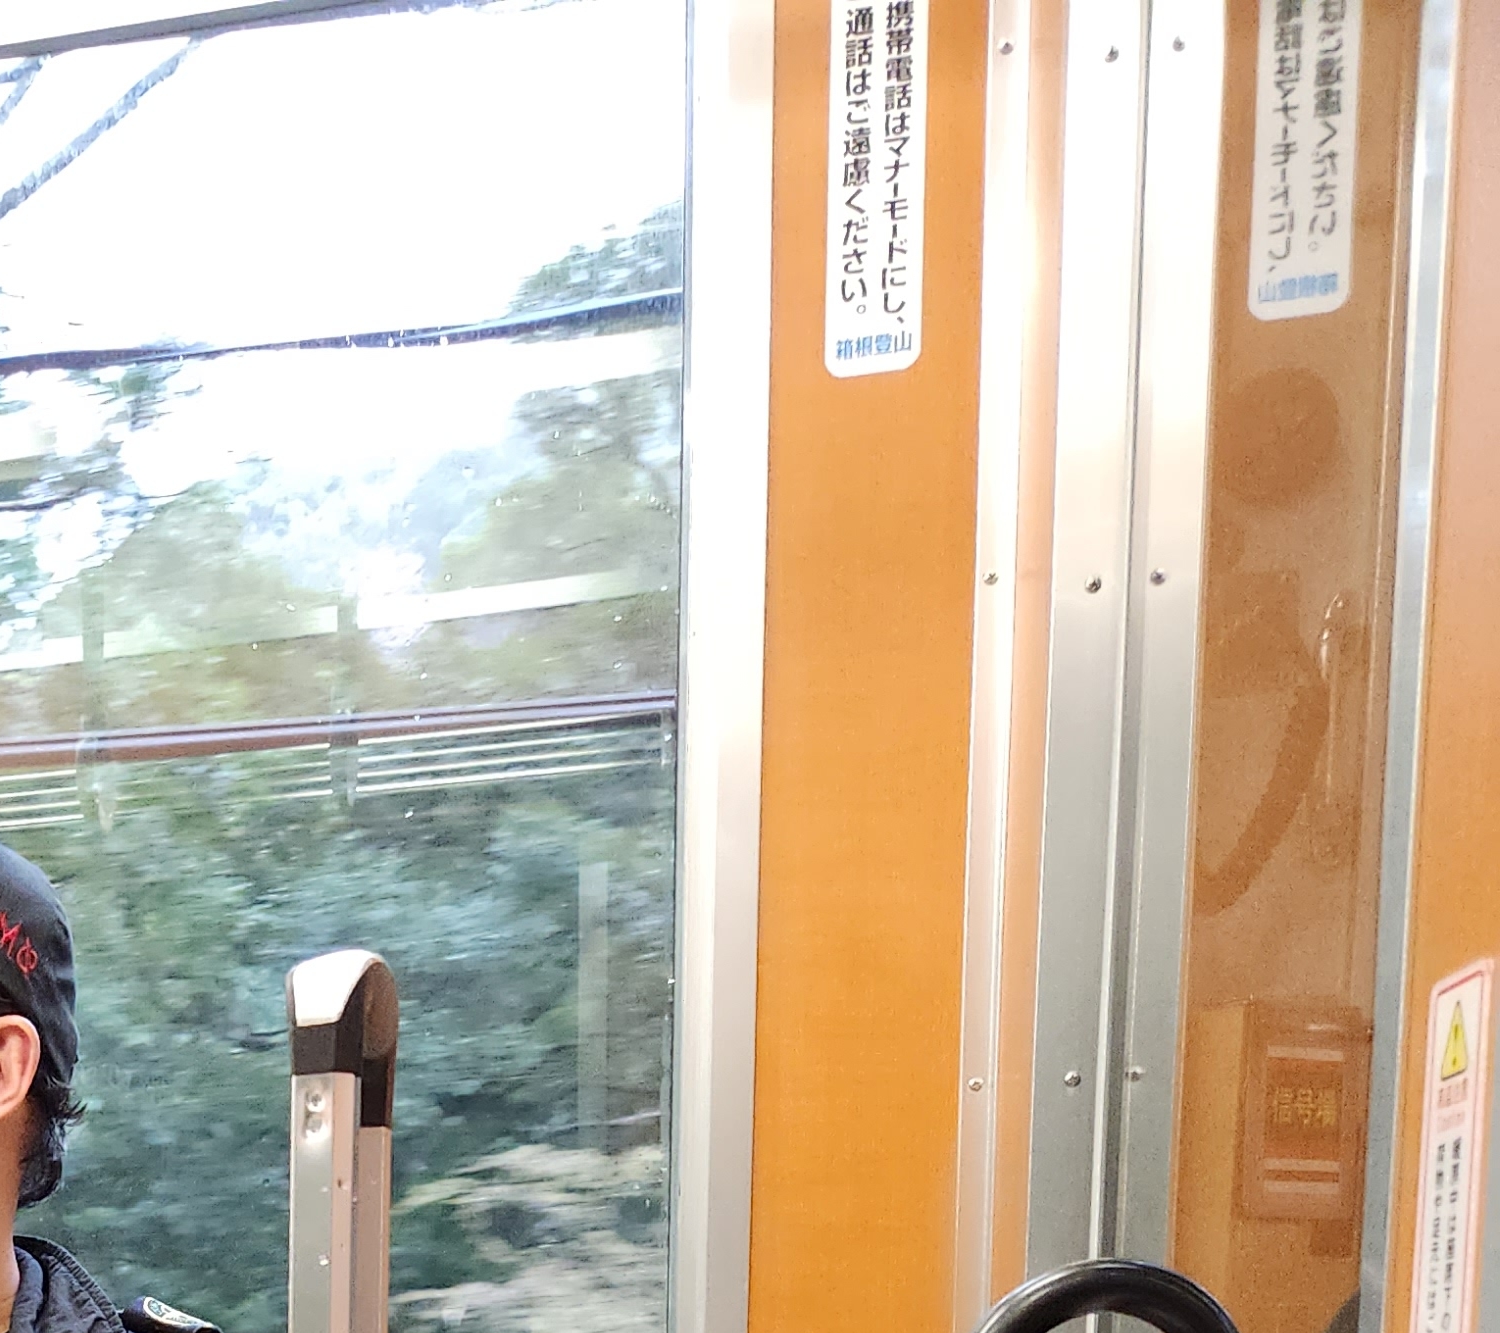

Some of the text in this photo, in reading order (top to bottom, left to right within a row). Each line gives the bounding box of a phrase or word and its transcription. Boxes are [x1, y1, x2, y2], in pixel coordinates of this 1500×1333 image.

[841, 5, 874, 314] 通話はご遠慮ください。
[880, 0, 915, 324] 携帯電話はマナーモードにし、
[836, 330, 913, 361] 箱根登山
